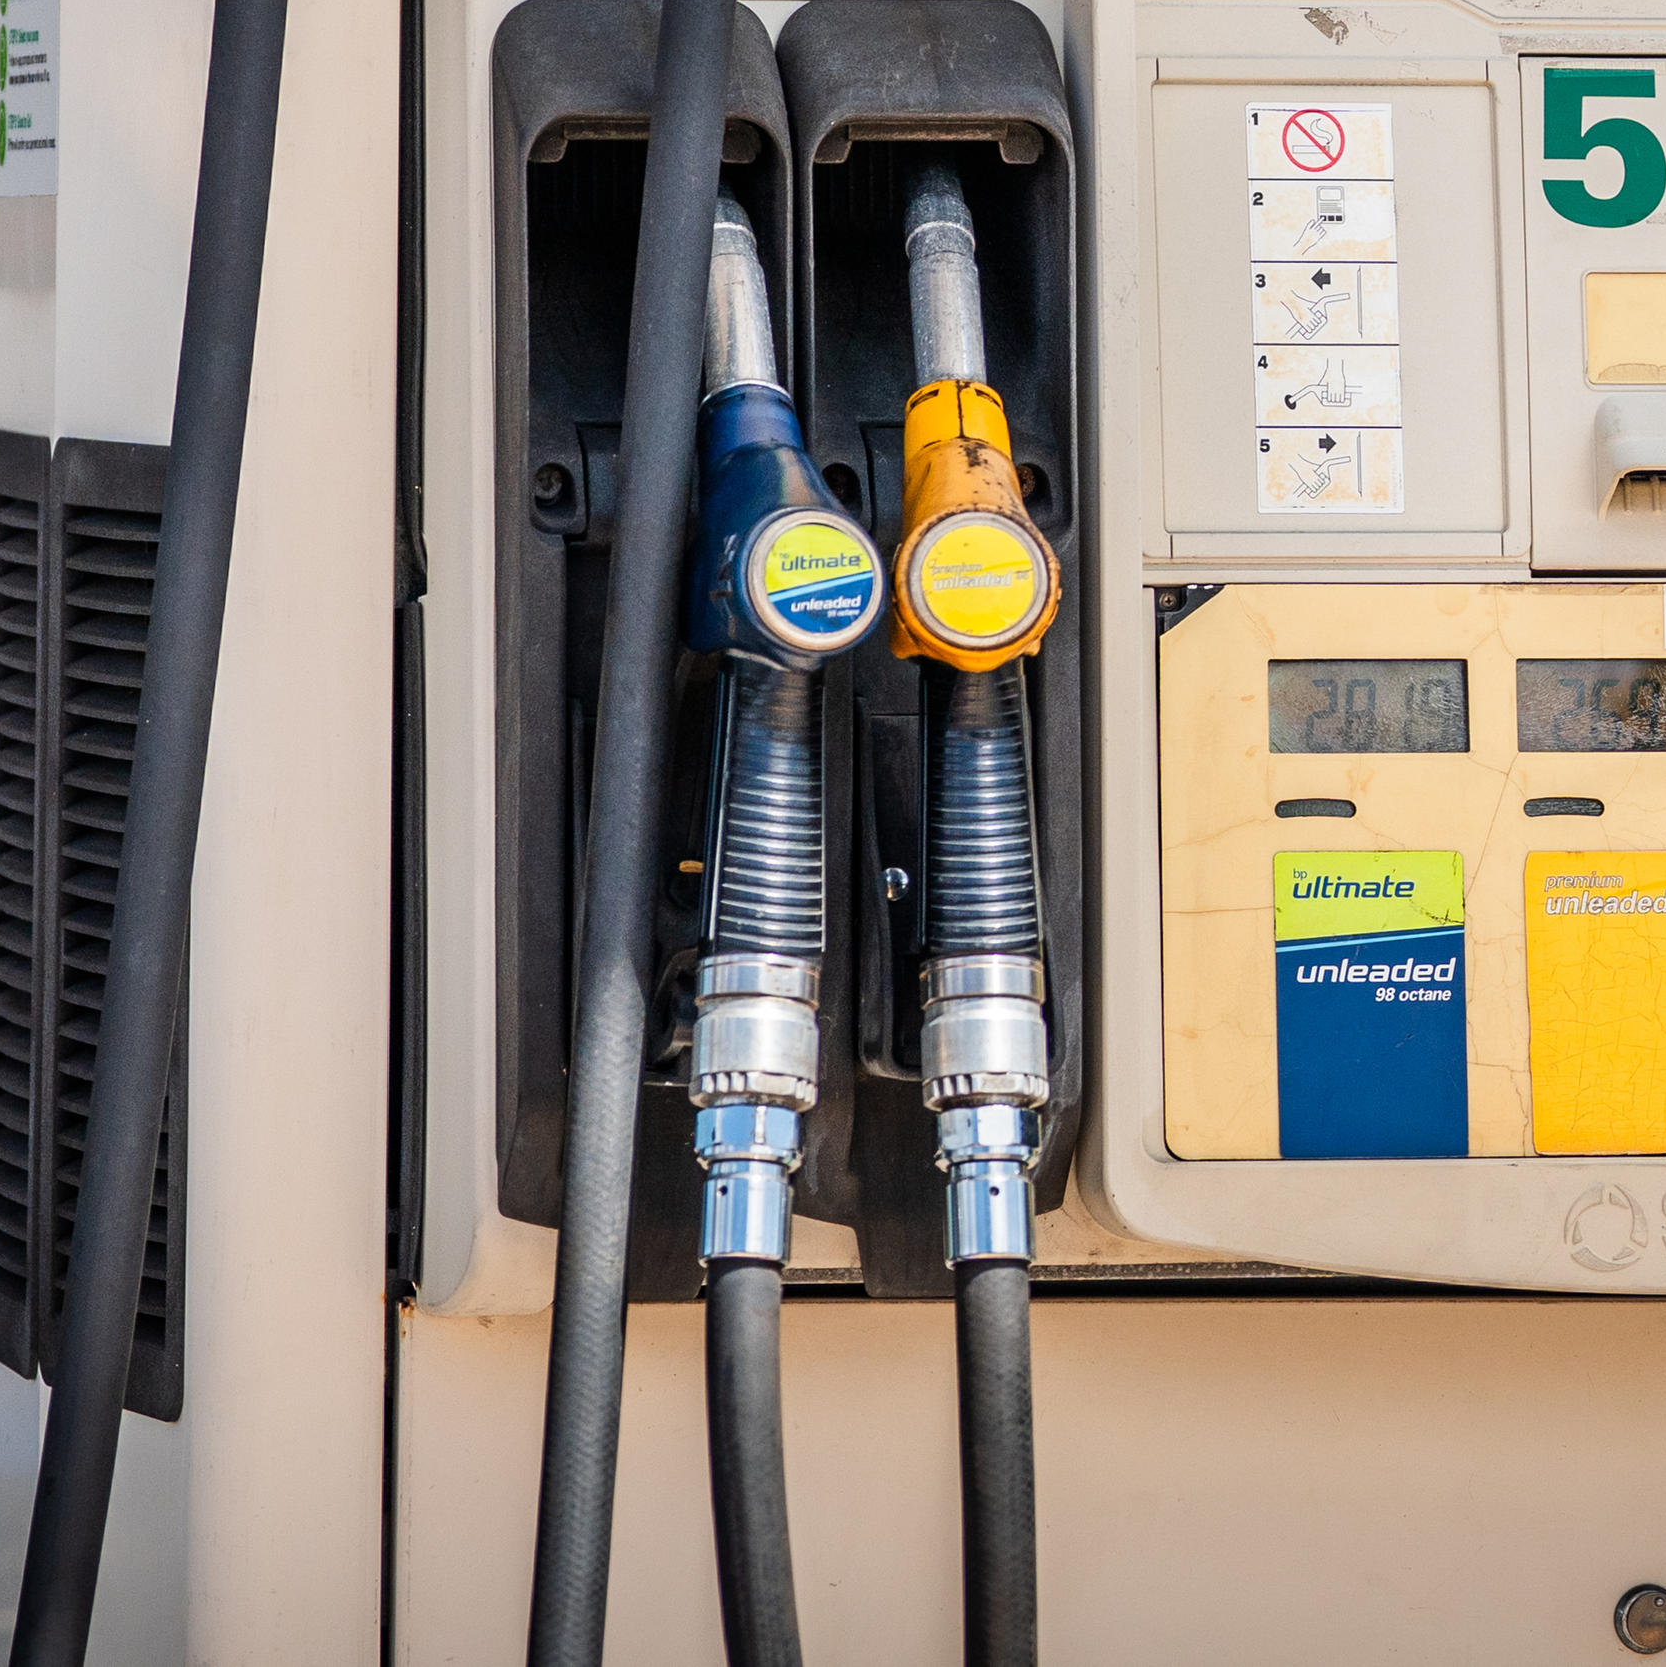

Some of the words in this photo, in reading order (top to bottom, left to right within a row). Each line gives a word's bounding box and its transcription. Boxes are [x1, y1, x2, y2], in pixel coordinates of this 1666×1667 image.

[1250, 112, 1259, 126] 1
[1541, 68, 1666, 228] 5
[1252, 192, 1264, 206] 2
[1254, 274, 1266, 288] 3
[1257, 355, 1269, 369] 4
[1259, 438, 1271, 453] 5
[781, 552, 861, 572] ultimate
[932, 571, 1013, 591] unleaded
[790, 594, 862, 612] unleaded
[1293, 868, 1308, 880] bp
[1544, 870, 1623, 892] premium
[1292, 875, 1415, 898] ultimate
[1296, 957, 1457, 983] unleaded
[1375, 987, 1395, 1002] 98
[1399, 988, 1452, 1001] octane
